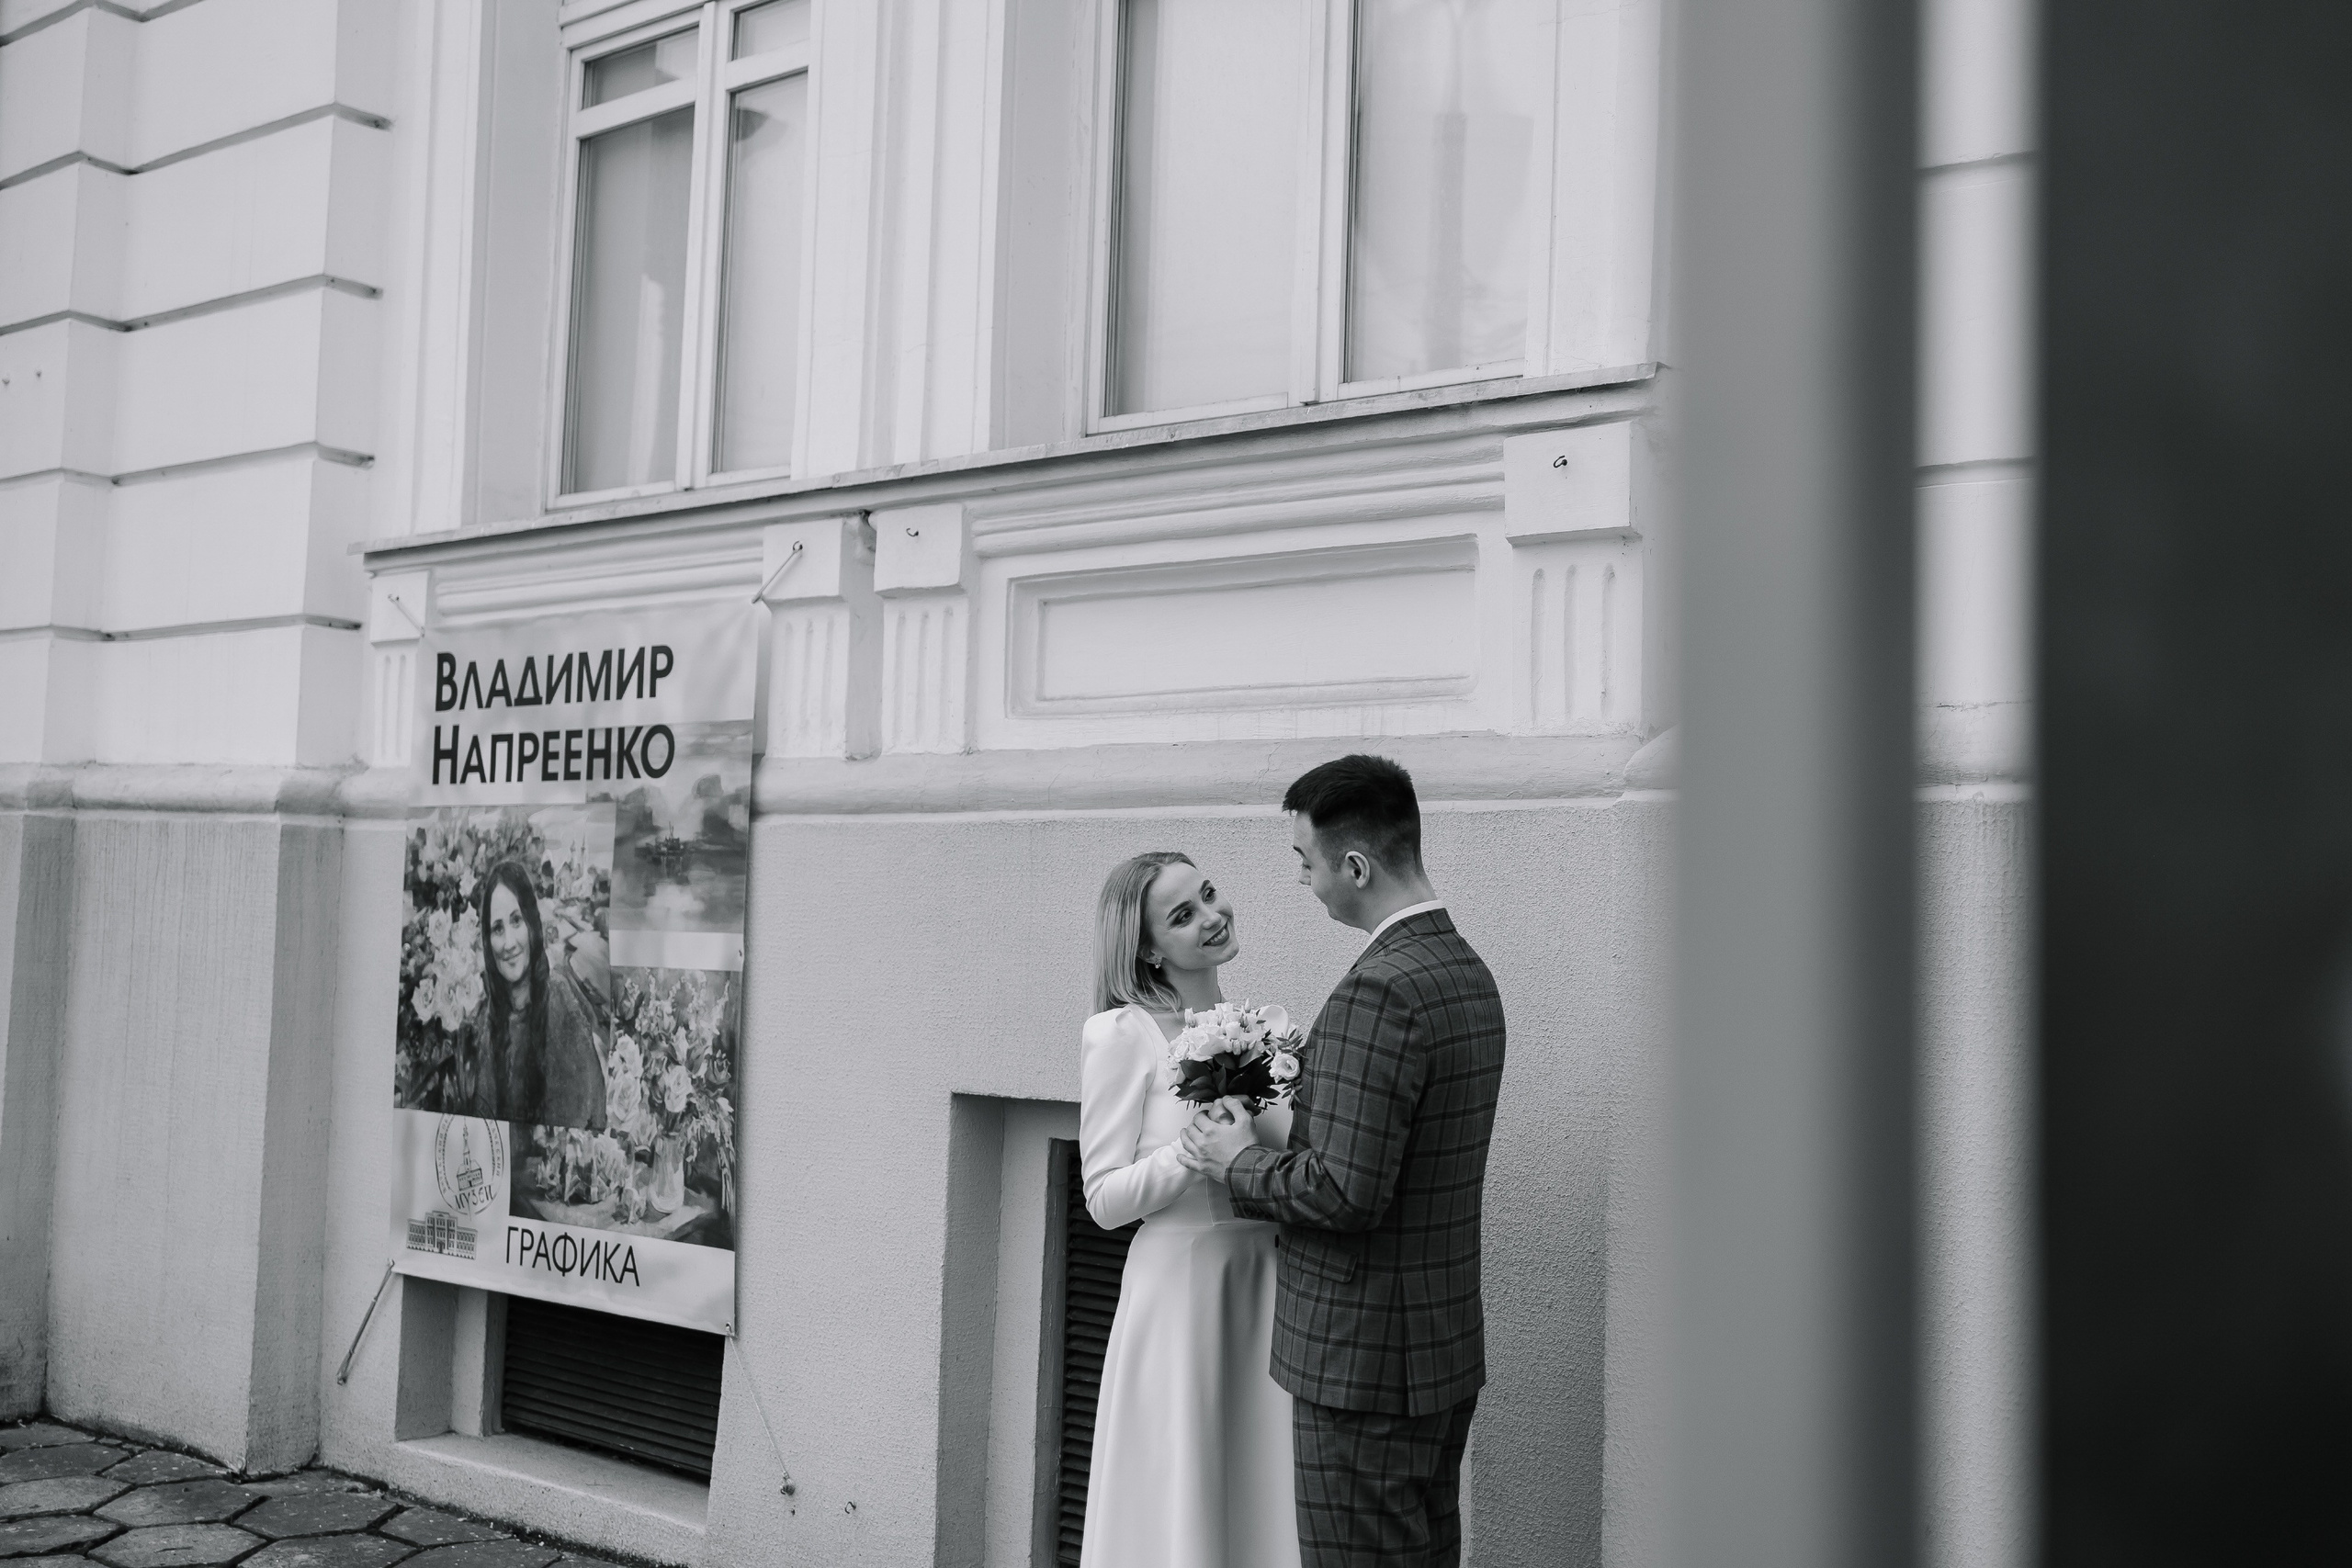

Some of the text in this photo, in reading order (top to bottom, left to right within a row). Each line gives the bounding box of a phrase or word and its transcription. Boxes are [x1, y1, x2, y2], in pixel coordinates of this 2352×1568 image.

[435, 645, 674, 712] ВЛАДИМИР
[432, 724, 675, 785] НАПРЕЕНКО
[505, 1224, 641, 1288] ГРАФИКА
